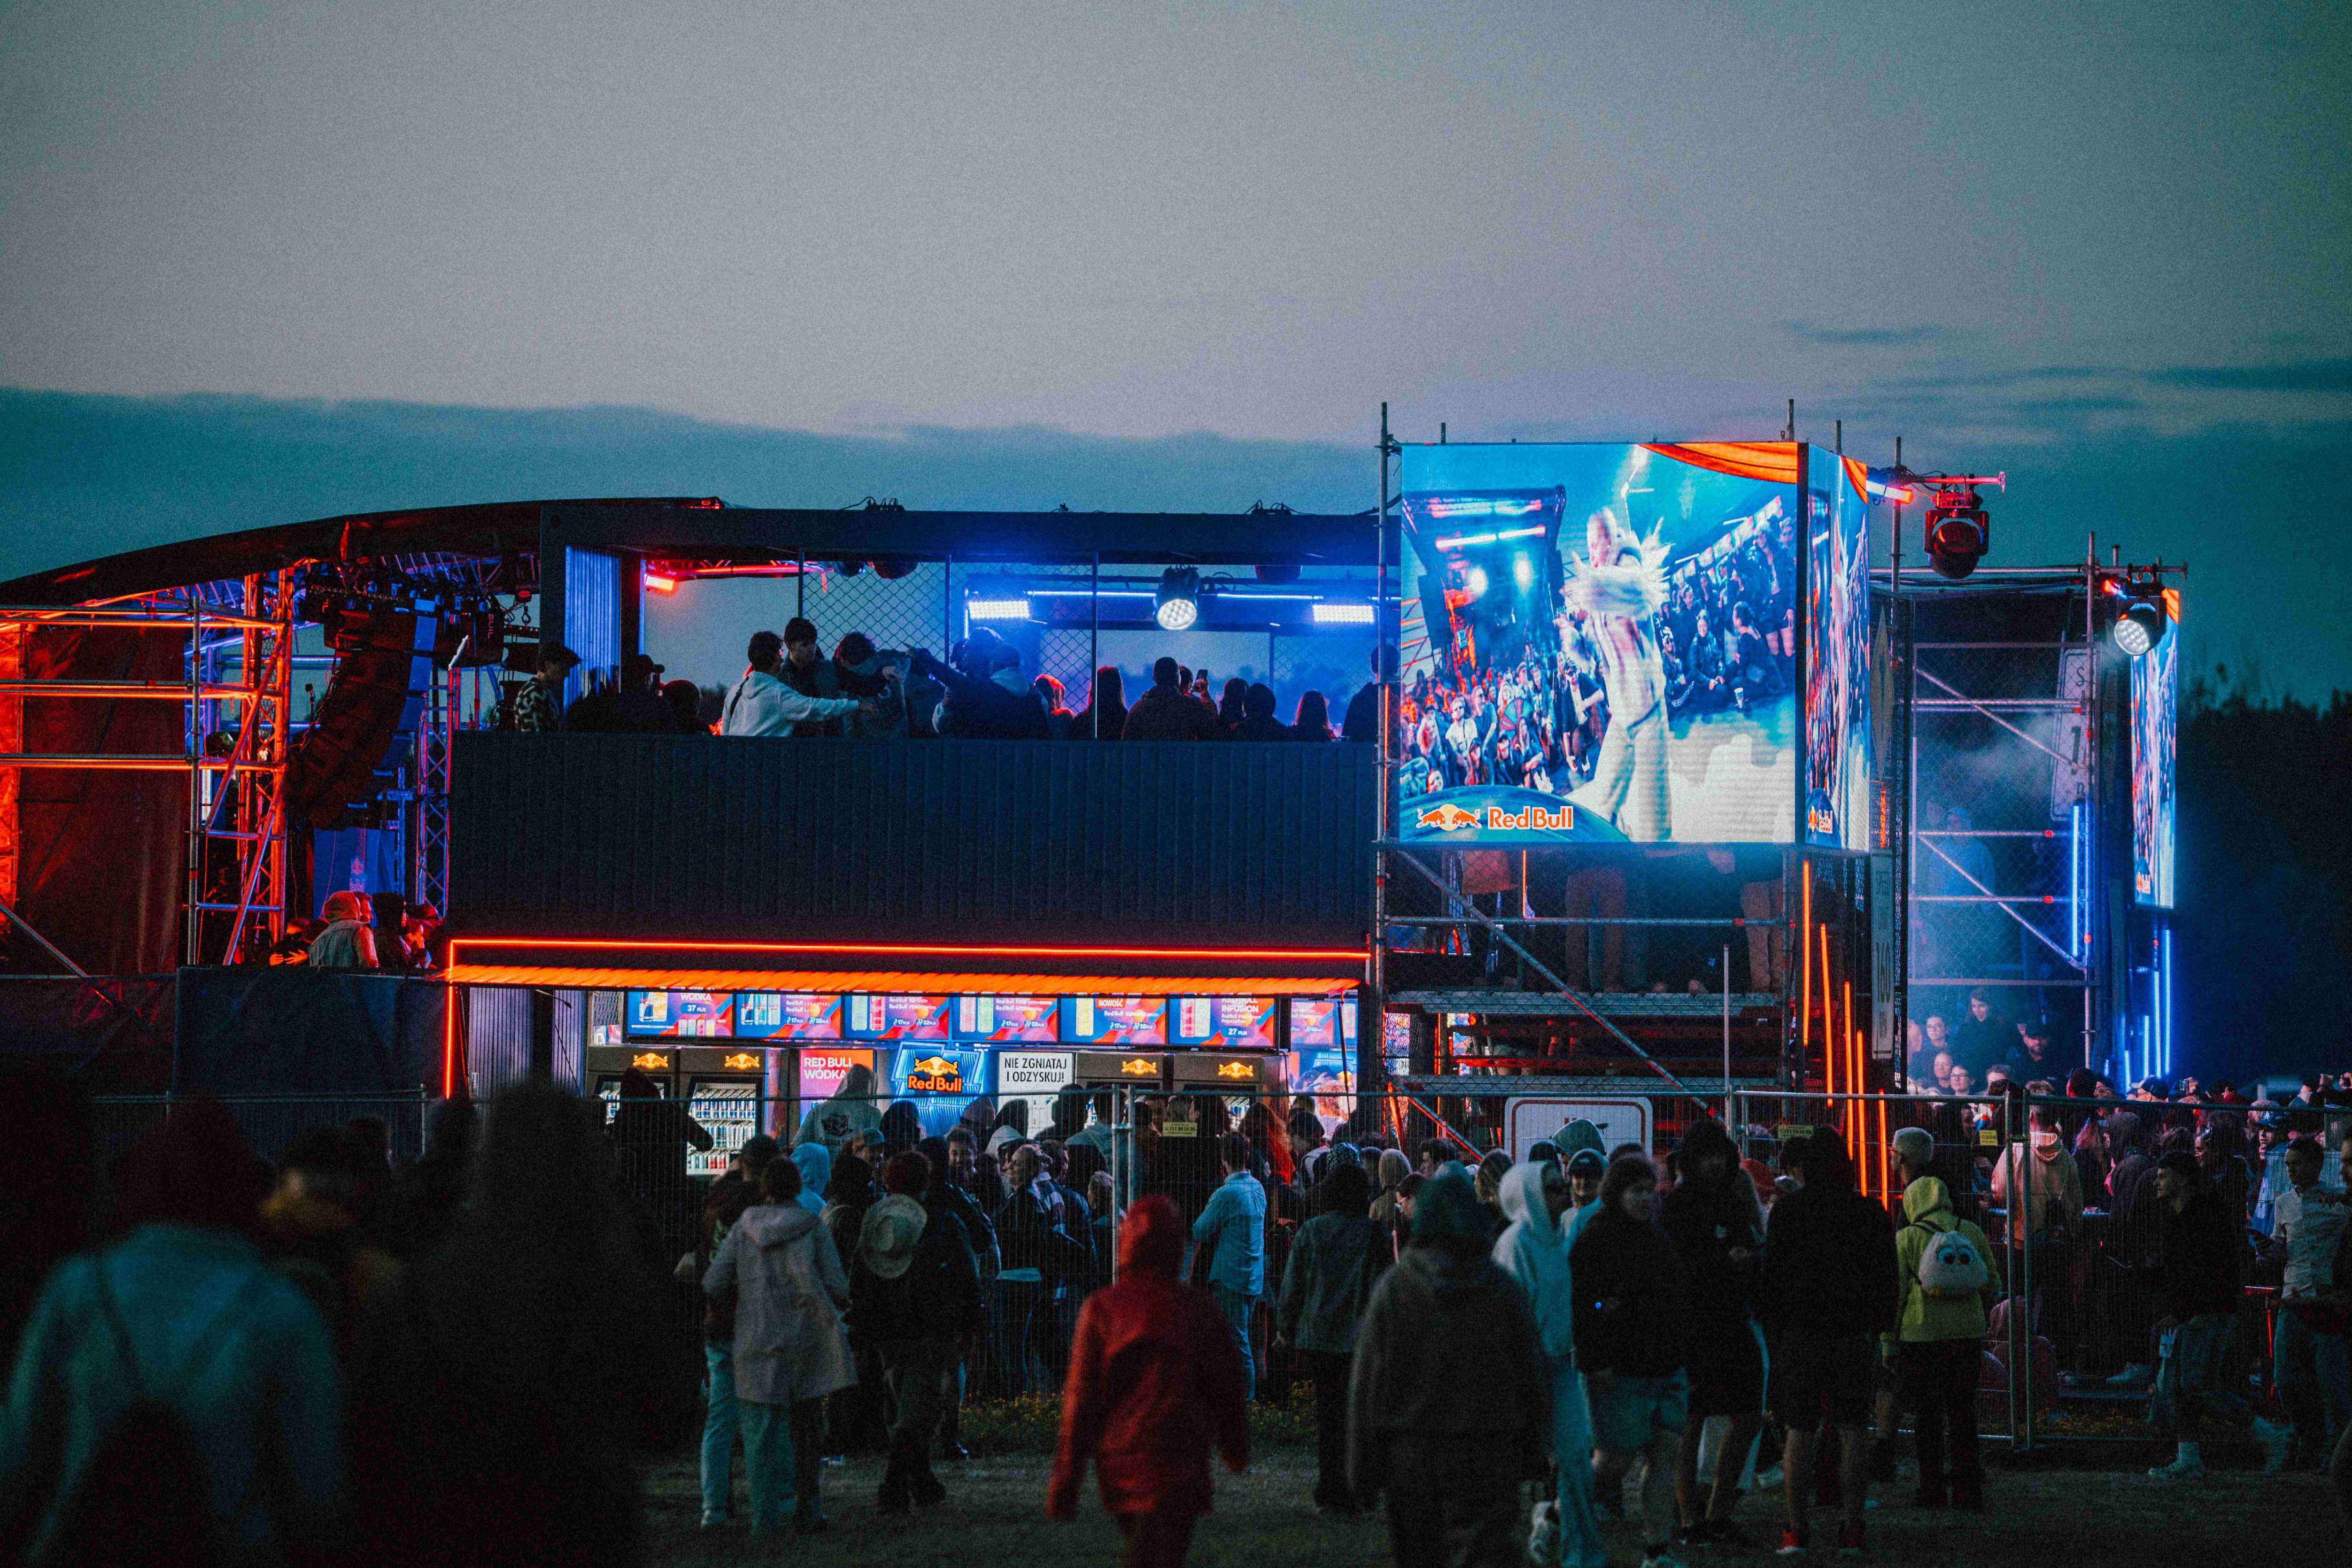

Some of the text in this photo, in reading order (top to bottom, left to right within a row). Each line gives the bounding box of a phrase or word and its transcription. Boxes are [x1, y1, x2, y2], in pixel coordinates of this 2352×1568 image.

[1489, 807, 1572, 828] Red Bull
[1099, 998, 1123, 1007] NOWOŚĆ
[1222, 1004, 1259, 1013] INFUSION
[804, 1058, 852, 1067] RED BULL
[1005, 1058, 1067, 1069] NIE ZGNIATAJ
[804, 1067, 846, 1080] WÓDKA
[1006, 1071, 1064, 1082] I ODZYSKUJ!
[908, 1074, 962, 1092] Red Bull
